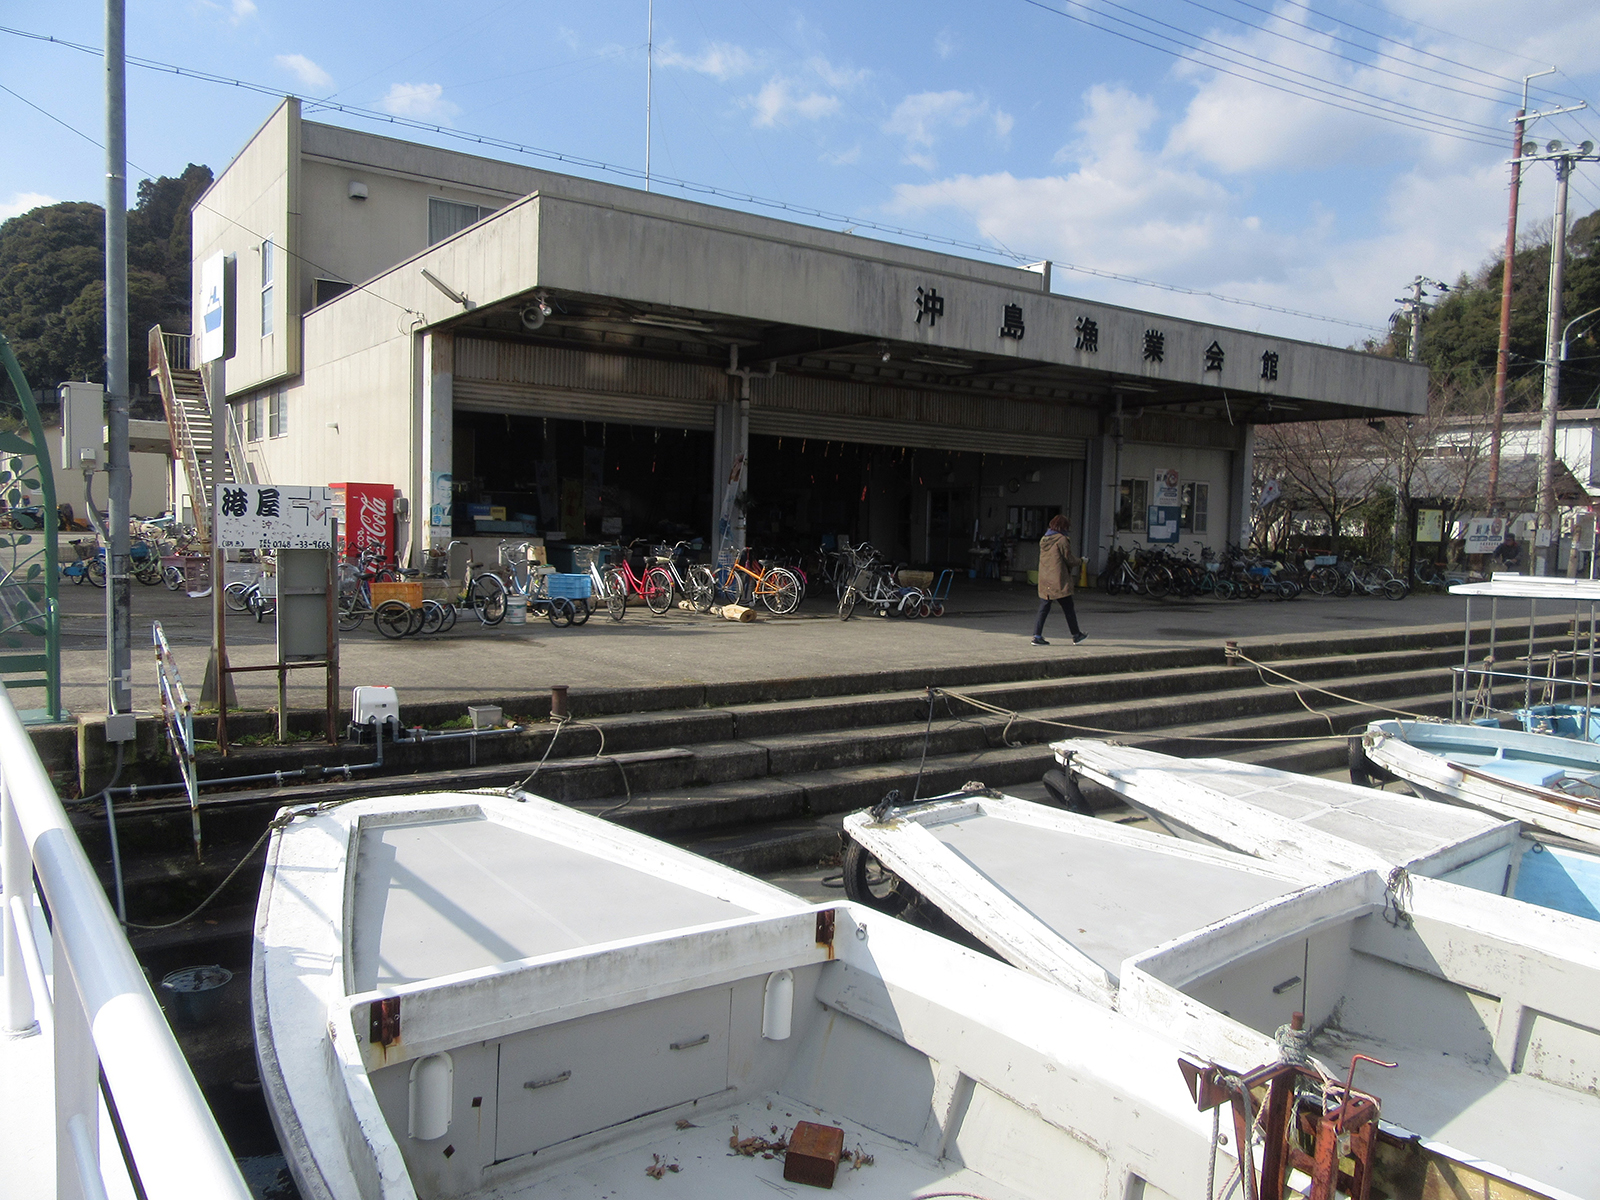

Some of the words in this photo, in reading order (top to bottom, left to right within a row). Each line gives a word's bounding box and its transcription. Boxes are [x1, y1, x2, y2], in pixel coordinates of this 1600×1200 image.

[914, 285, 1280, 382] 沖島漁業会館
[222, 487, 280, 518] 港屋
